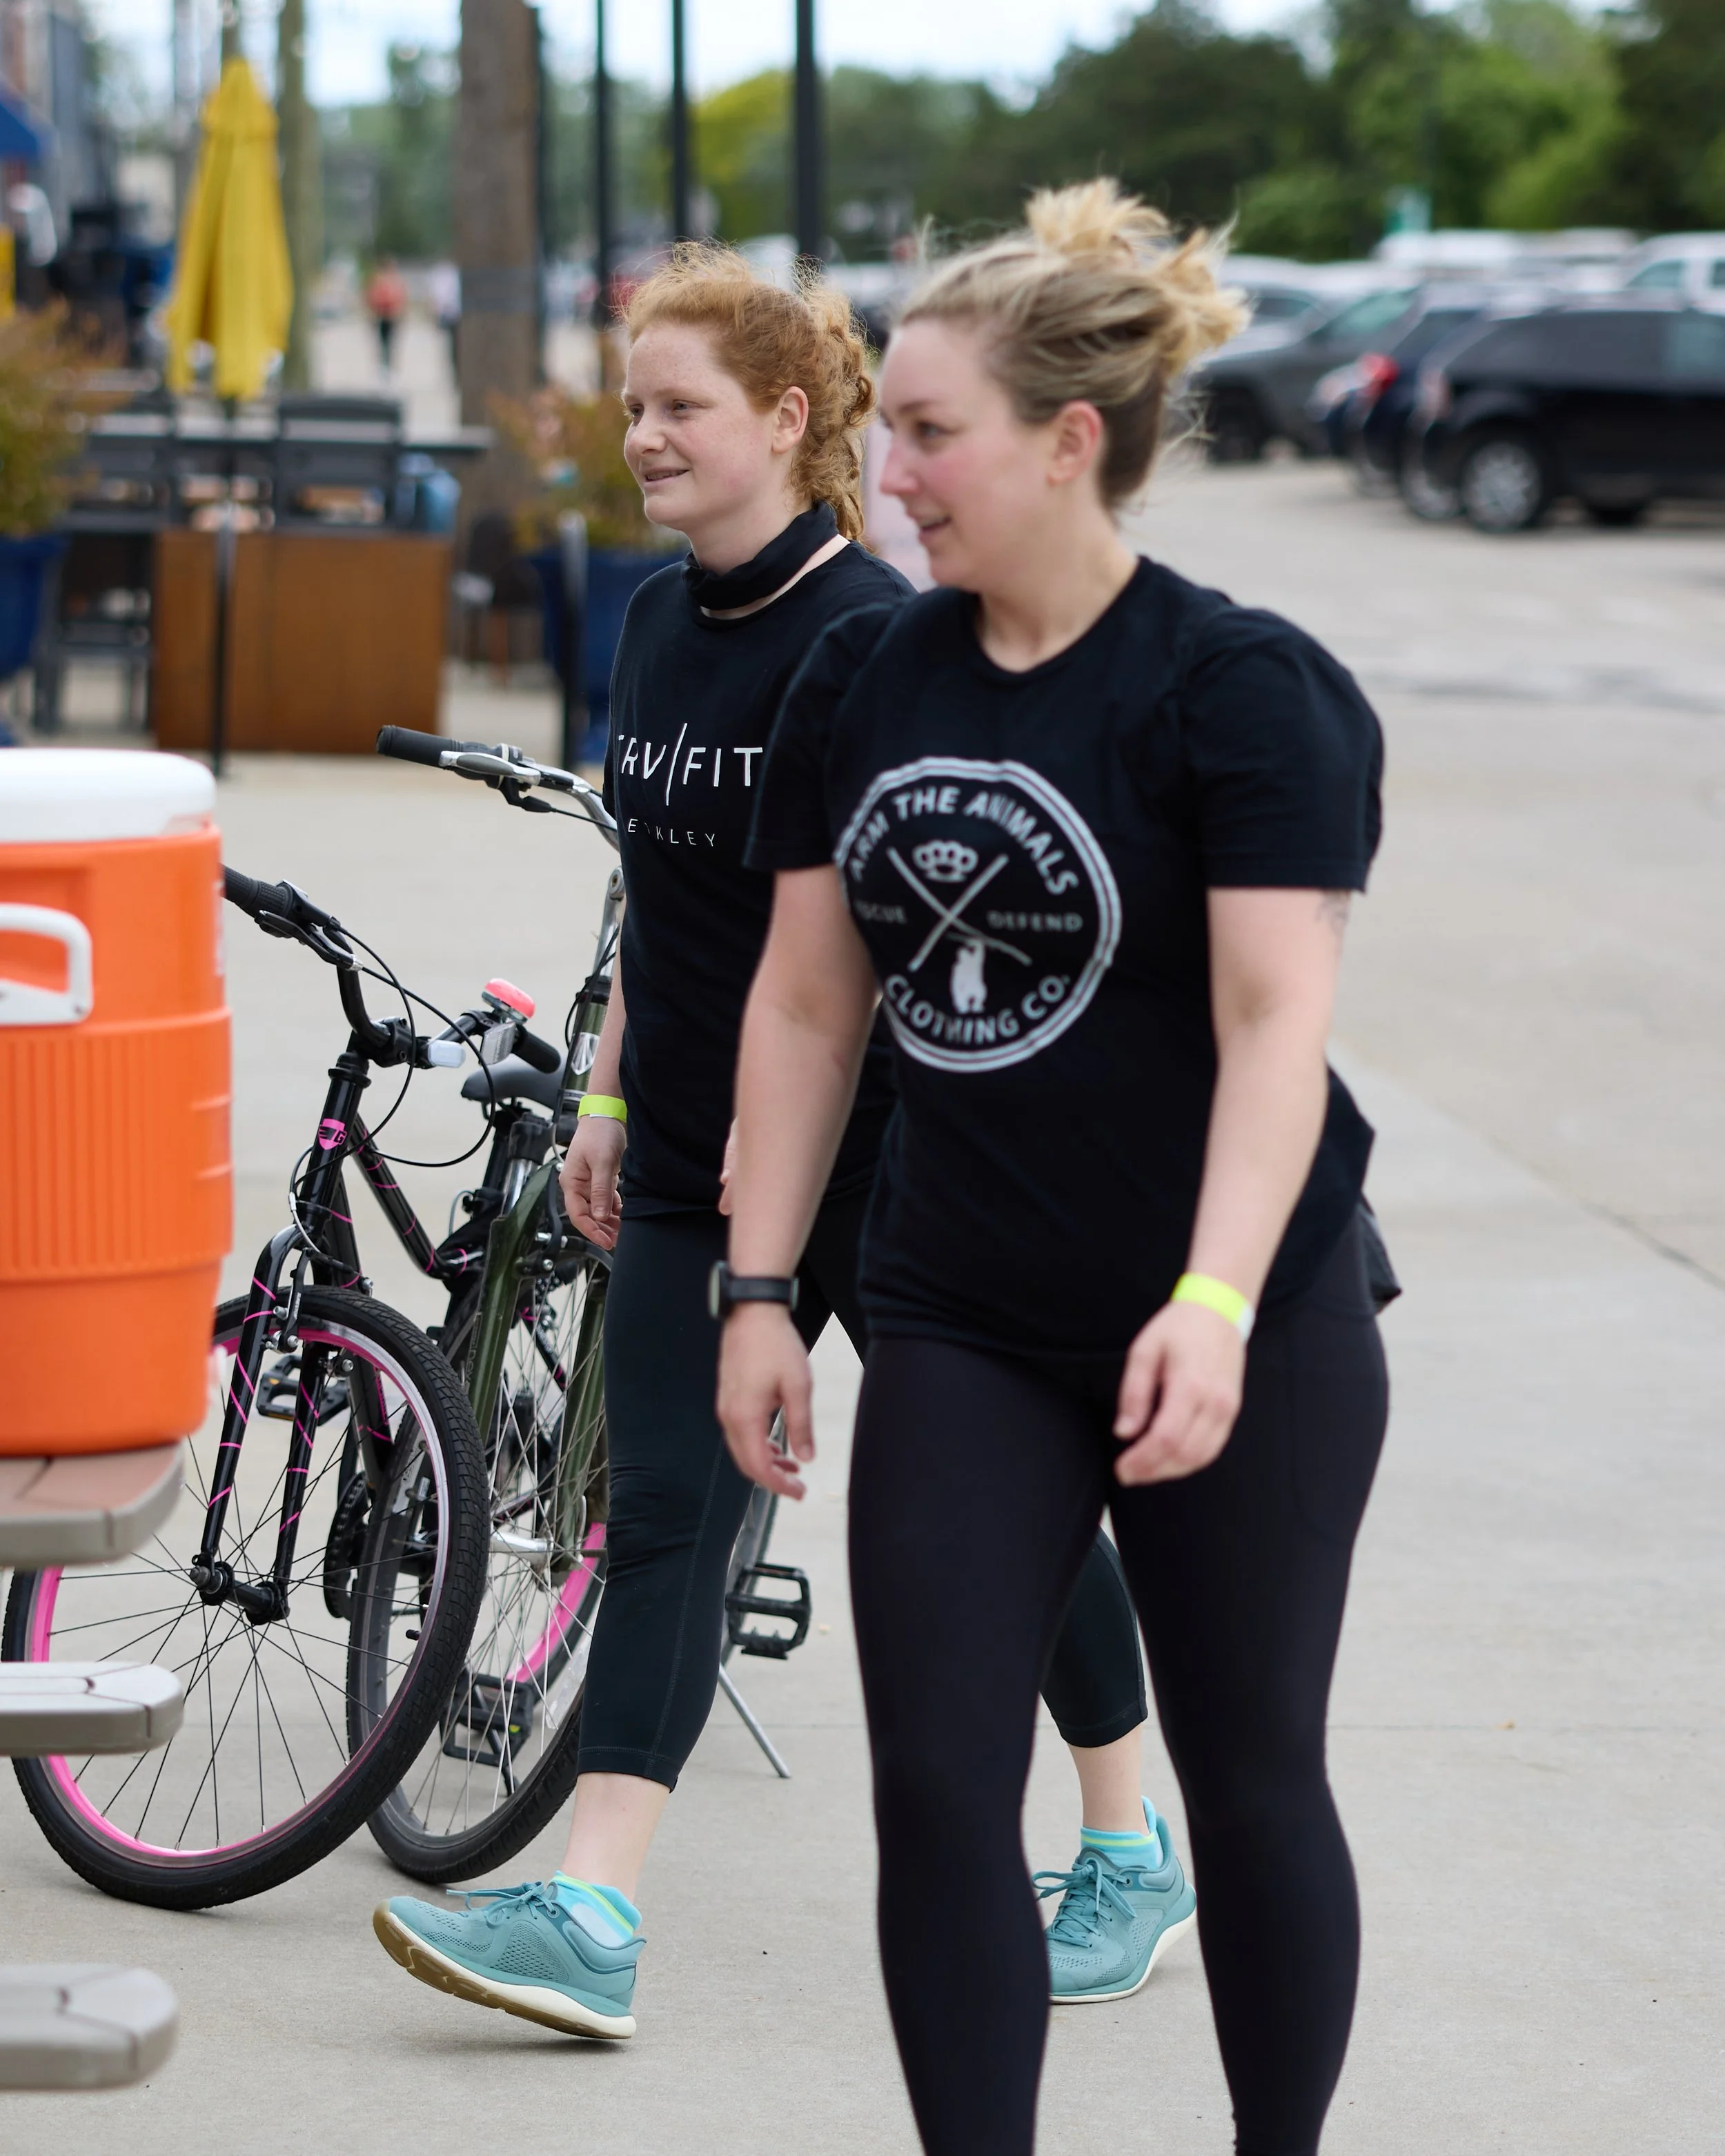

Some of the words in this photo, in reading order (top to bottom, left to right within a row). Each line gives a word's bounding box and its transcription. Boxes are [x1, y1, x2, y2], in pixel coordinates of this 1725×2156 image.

[618, 722, 763, 806] RV/FIT
[849, 811, 889, 882] ARM
[891, 786, 960, 820] THE
[965, 791, 1079, 894] ANIMALS
[987, 909, 1083, 932] DEFEND
[885, 974, 1019, 1045] CLOTHING
